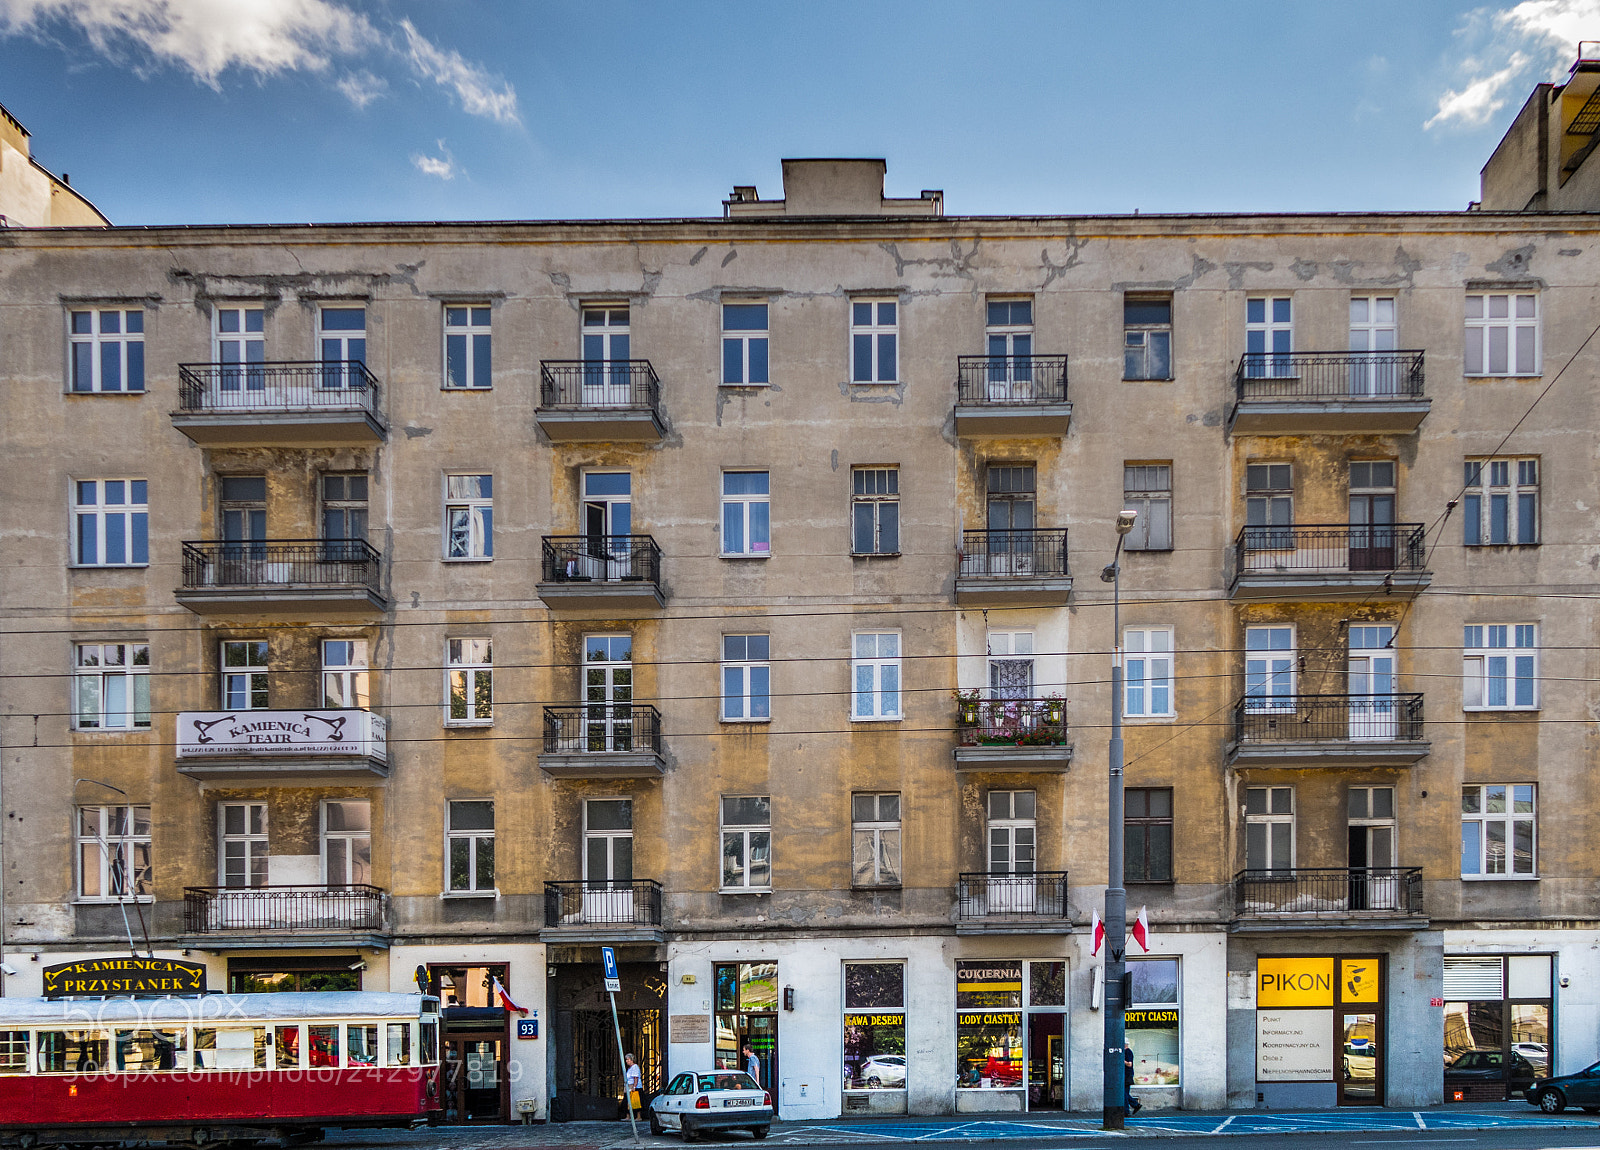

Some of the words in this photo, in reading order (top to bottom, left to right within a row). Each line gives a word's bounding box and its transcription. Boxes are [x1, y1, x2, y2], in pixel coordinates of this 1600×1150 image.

[229, 721, 311, 738] KAMIENICA
[246, 734, 292, 743] TEATR
[74, 960, 173, 973] KAMIENICA
[605, 951, 613, 974] P
[958, 968, 1022, 979] CUKIERNIA
[64, 978, 184, 992] PRZYSTANEK
[1261, 973, 1330, 991] PIKON
[845, 1015, 868, 1026] KAWA
[871, 1015, 904, 1025] DESERY
[960, 1015, 982, 1025] LODY
[984, 1013, 1019, 1024] CIASTKA
[1124, 1012, 1147, 1022] ORTY
[1148, 1011, 1178, 1021] CIASTA
[521, 1024, 534, 1035] 93
